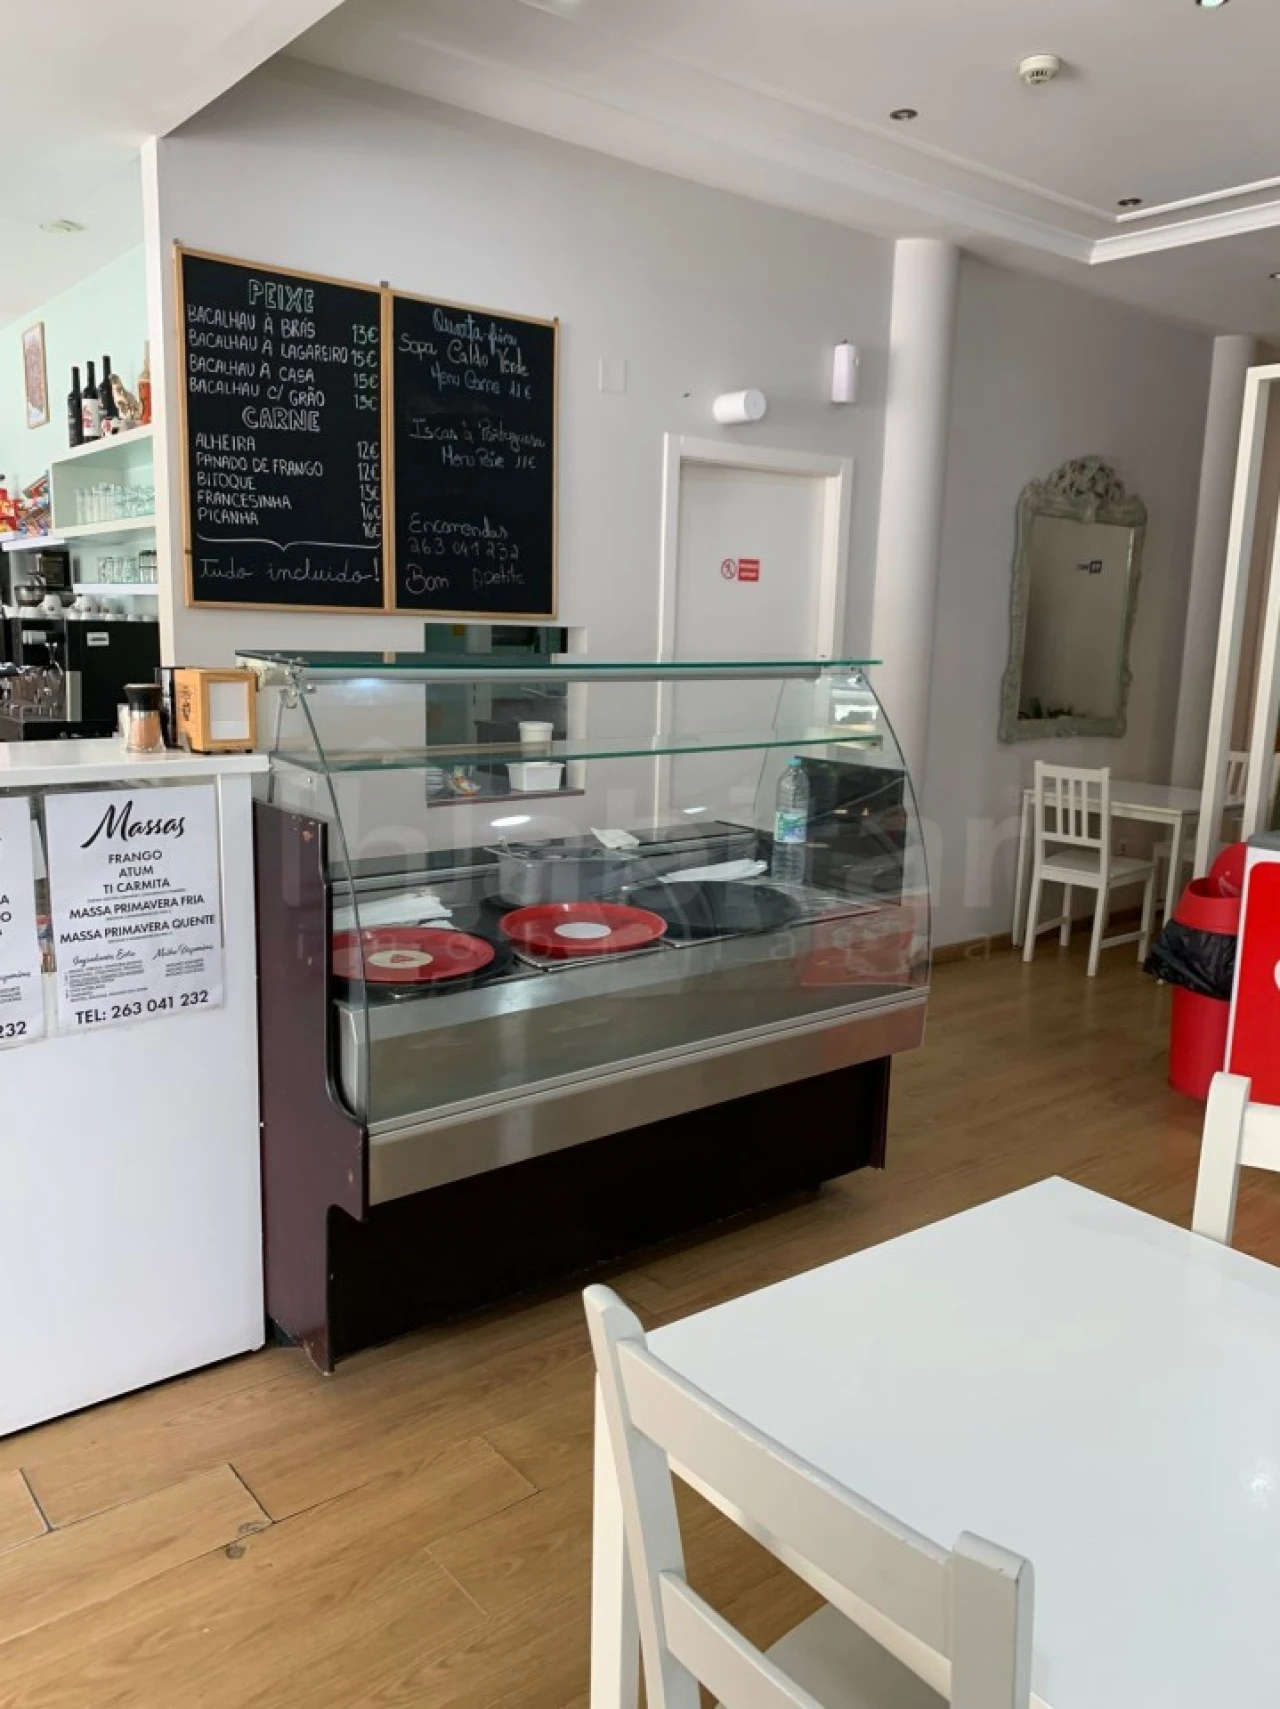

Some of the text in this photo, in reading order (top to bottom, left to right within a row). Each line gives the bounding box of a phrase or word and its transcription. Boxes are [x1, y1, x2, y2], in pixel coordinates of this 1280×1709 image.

[248, 278, 314, 314] PEIXE
[187, 303, 256, 331] BACALHAU
[188, 328, 259, 352] BACALHAU
[280, 343, 348, 364] LAGAREIRO
[350, 350, 378, 368] 15€
[447, 339, 489, 368] Caldo
[189, 353, 257, 377] BACALHAU
[279, 366, 316, 384] CASA
[353, 372, 379, 389] 15€
[189, 376, 261, 398] BACALHAU
[289, 385, 326, 407] GRÃO
[241, 405, 321, 433] CARNE
[195, 432, 379, 460] ALHEIRA 12€
[195, 451, 380, 481] PANADO DE FRANGO 12€
[197, 471, 256, 491] BITOQUE
[197, 490, 292, 510] FRANCESINHA
[198, 507, 259, 525] PICANHA
[407, 537, 446, 556] 263
[199, 556, 254, 579] Tudo
[405, 563, 449, 595] Bom
[80, 799, 186, 849] Massas
[108, 850, 163, 865] FRANGO
[103, 877, 171, 895] TI CARMITA
[118, 865, 154, 879] ATUM
[69, 905, 112, 920] MASSA
[113, 896, 179, 915] PRIMAVERA
[181, 894, 205, 906] FRIA
[60, 928, 102, 944] MASSA
[104, 920, 170, 939] PRIMAVERA
[172, 914, 216, 930] QUENTE
[75, 989, 209, 1025] TEL: 263 041 232
